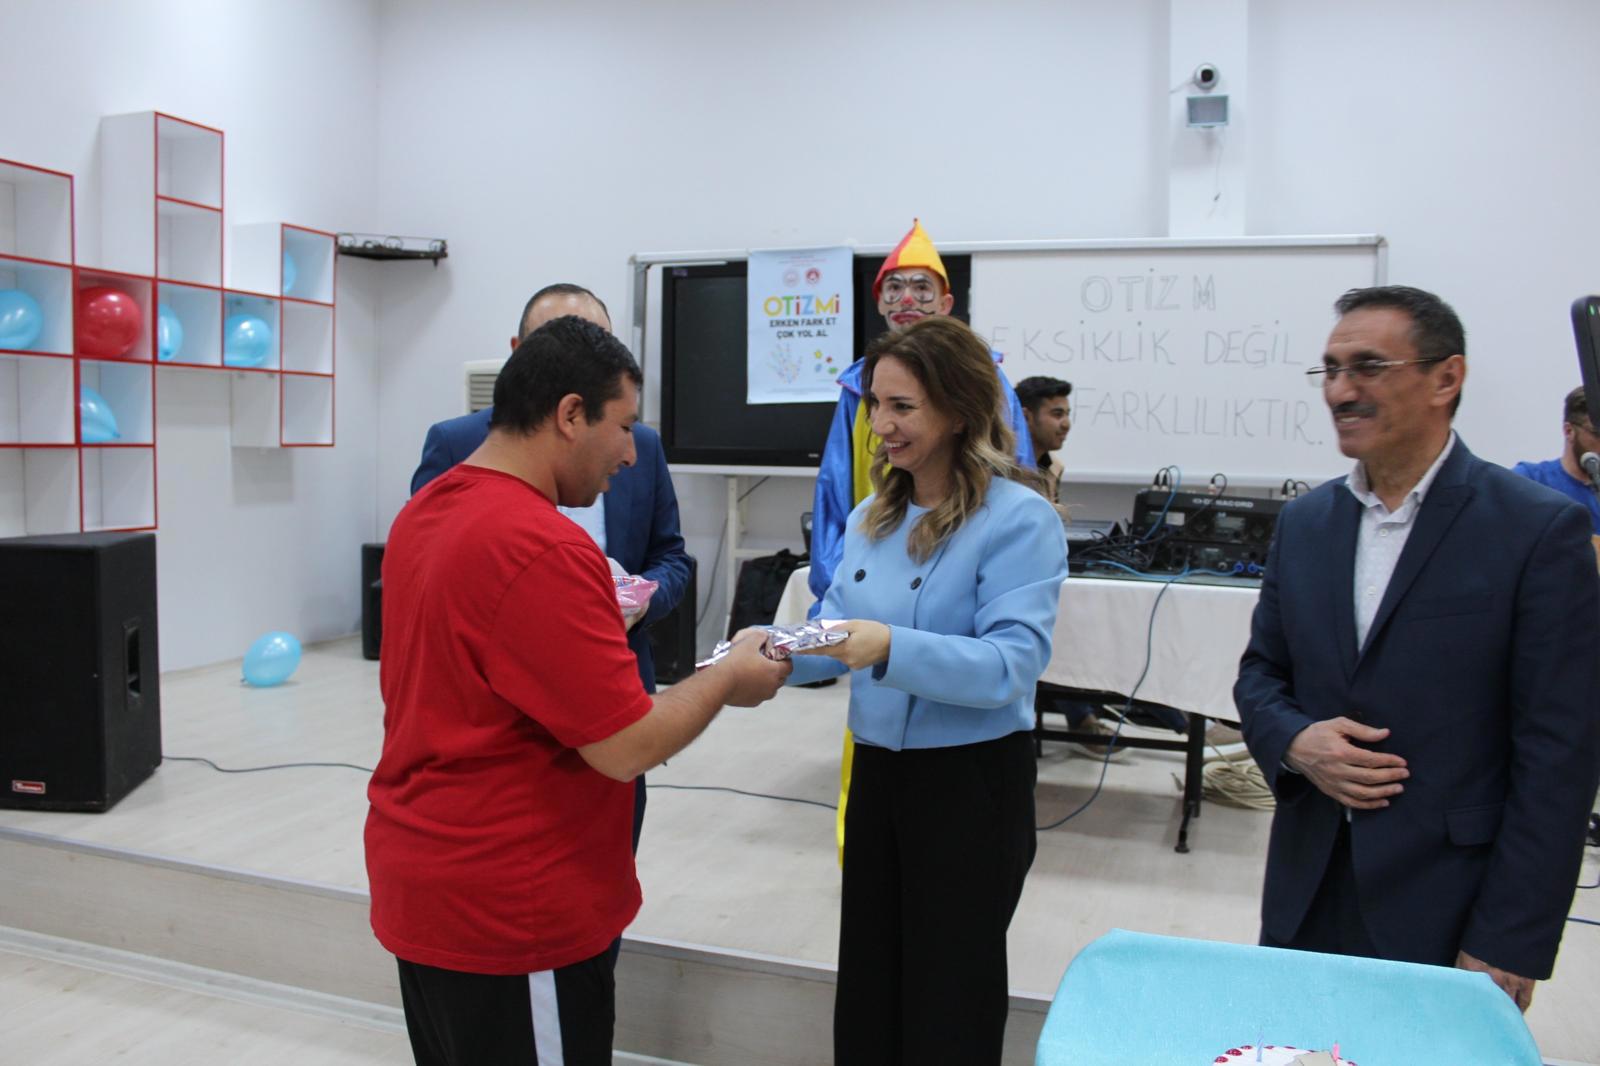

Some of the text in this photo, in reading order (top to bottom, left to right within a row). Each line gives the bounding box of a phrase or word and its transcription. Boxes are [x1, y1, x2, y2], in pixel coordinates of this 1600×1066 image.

[769, 316, 837, 328] ERKEN FARK ET
[776, 328, 828, 339] ÇOK YOL AL
